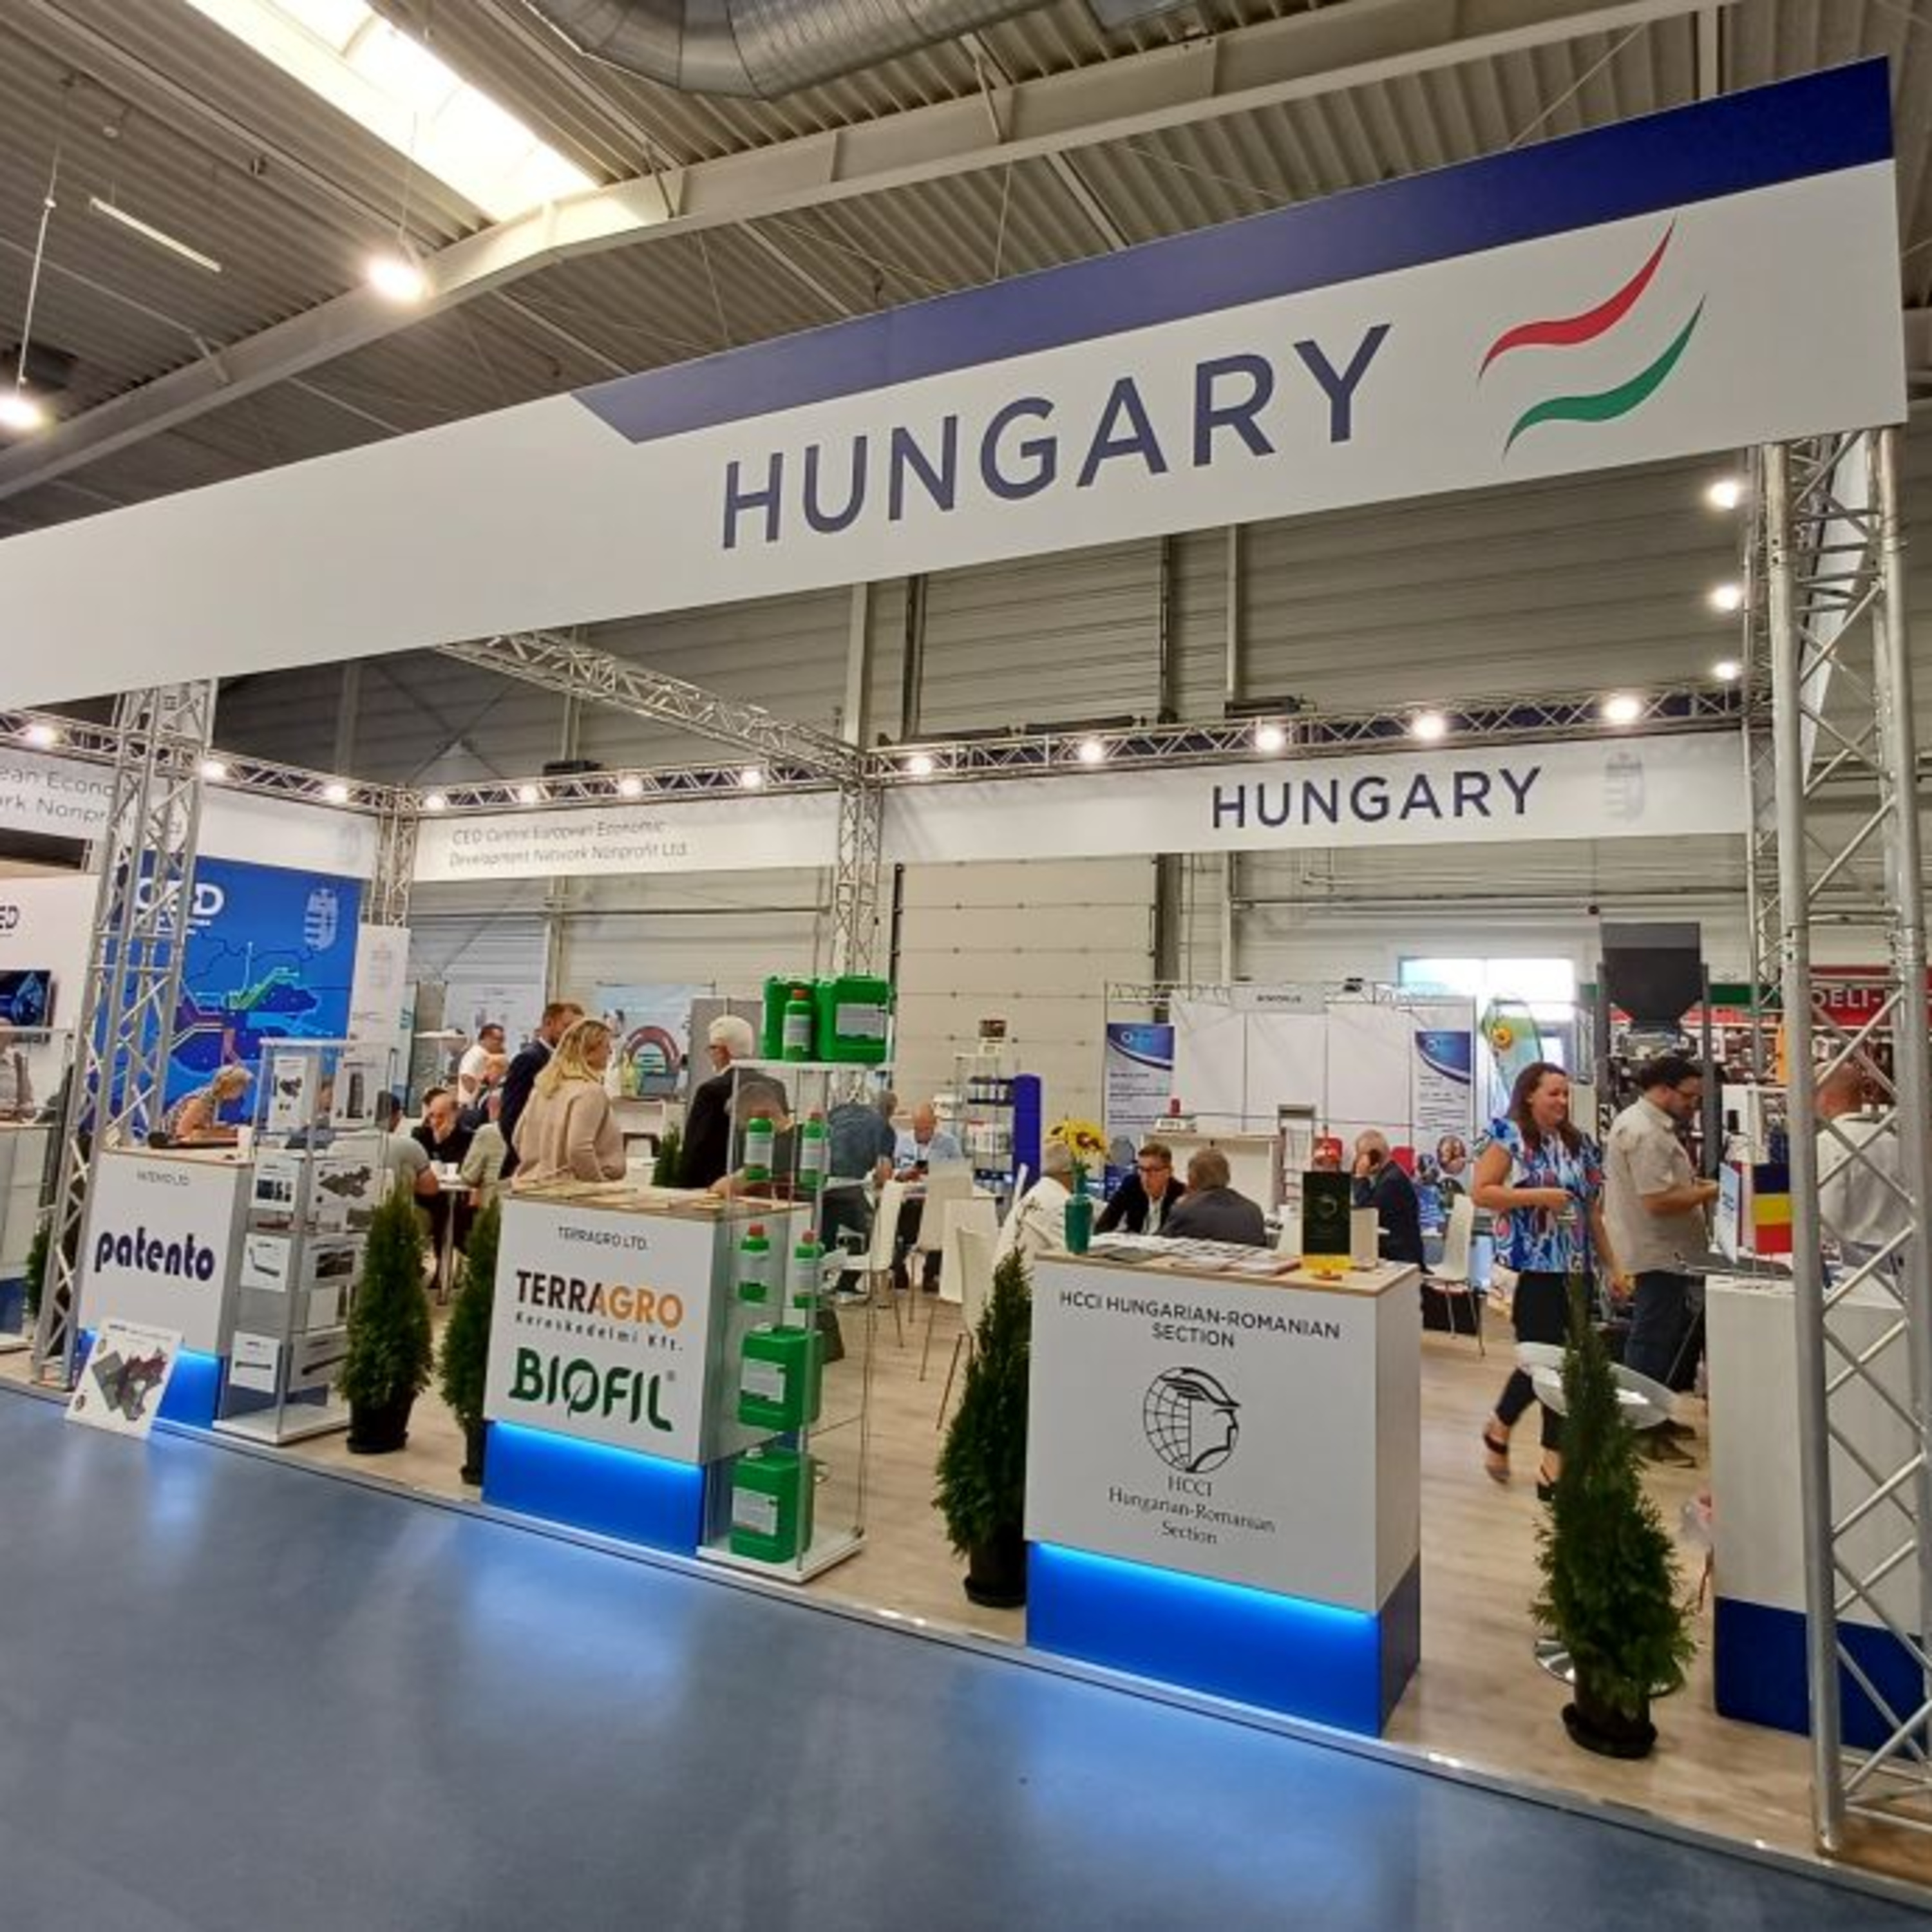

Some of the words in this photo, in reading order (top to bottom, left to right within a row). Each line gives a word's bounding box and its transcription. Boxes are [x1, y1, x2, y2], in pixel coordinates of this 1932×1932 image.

[723, 324, 1391, 549] HUNGARY
[1213, 766, 1540, 829] HUNGARY
[94, 1226, 215, 1281] patento
[558, 1226, 621, 1248] TERRAGRO
[515, 1269, 683, 1329] TERRAGRO
[1059, 1291, 1101, 1310] HCCI
[1106, 1296, 1340, 1339] HUNGARIAN-ROMANIAN
[1151, 1322, 1235, 1348] SECTION
[1109, 1486, 1276, 1533] Hungarian-Romanian
[1168, 1475, 1212, 1497] HCCI
[1161, 1520, 1217, 1544] Section
